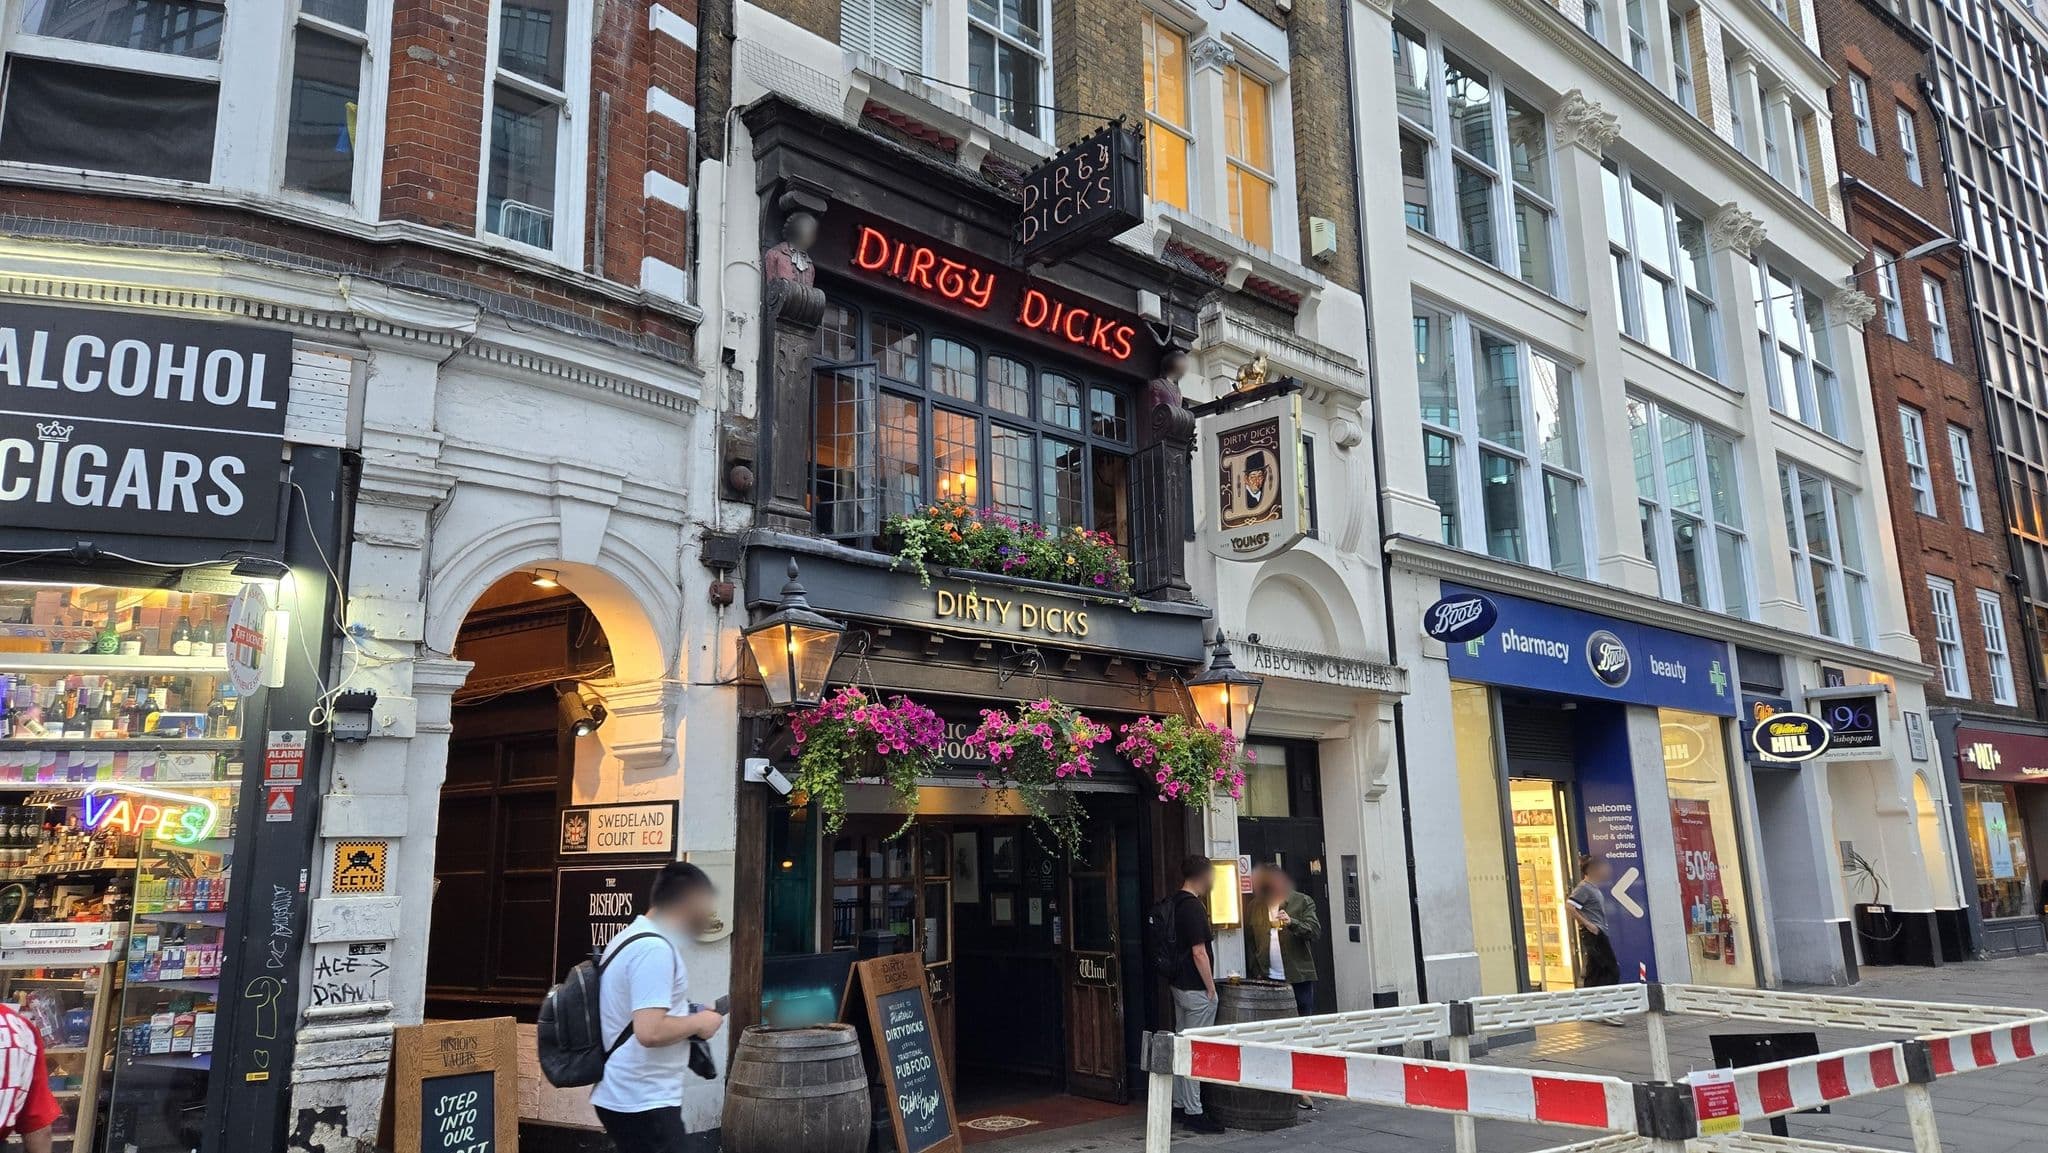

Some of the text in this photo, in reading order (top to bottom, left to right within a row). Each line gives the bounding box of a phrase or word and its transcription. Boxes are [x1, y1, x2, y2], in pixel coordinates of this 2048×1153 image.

[1022, 143, 1111, 213] DIRTY
[1022, 176, 1112, 245] DICKS
[858, 228, 1136, 361] DIRTY DICKS
[0, 326, 277, 411] ALCOHOL
[1223, 424, 1276, 447] DIRTY DICKS
[0, 438, 247, 517] CIGARS
[1230, 532, 1270, 549] YOUNG'S
[936, 590, 1089, 635] DIRTY DICKS
[1429, 597, 1483, 635] Boots
[1501, 628, 1687, 684] pharmacy Boots beauty
[1254, 653, 1393, 686] ABBOTTS CHAMBERS
[1828, 705, 1872, 730] 196
[268, 750, 303, 759] ALARM
[1770, 735, 1811, 753] HILL
[84, 794, 204, 844] VAPES
[1588, 804, 1632, 813] welcome
[1598, 815, 1632, 823] pharmacy
[598, 812, 664, 829] SWEDELAND
[597, 831, 663, 847] COURT EC2
[1616, 832, 1634, 840] drink
[1685, 850, 1715, 880] 50%
[339, 875, 378, 886] CCTV
[605, 878, 617, 888] THE
[589, 892, 633, 916] BISHOP'S
[882, 960, 905, 974] DIRTY
[884, 970, 908, 984] DICKS
[885, 1020, 925, 1042] DIRTY DICKS
[442, 1051, 477, 1067] VAULTS
[895, 1055, 931, 1079] PUB FOOD
[434, 1090, 478, 1116] STEP
[440, 1108, 477, 1133] INTO
[920, 1125, 928, 1133] THE
[927, 1118, 935, 1130] CITY
[443, 1125, 475, 1147] OUR
